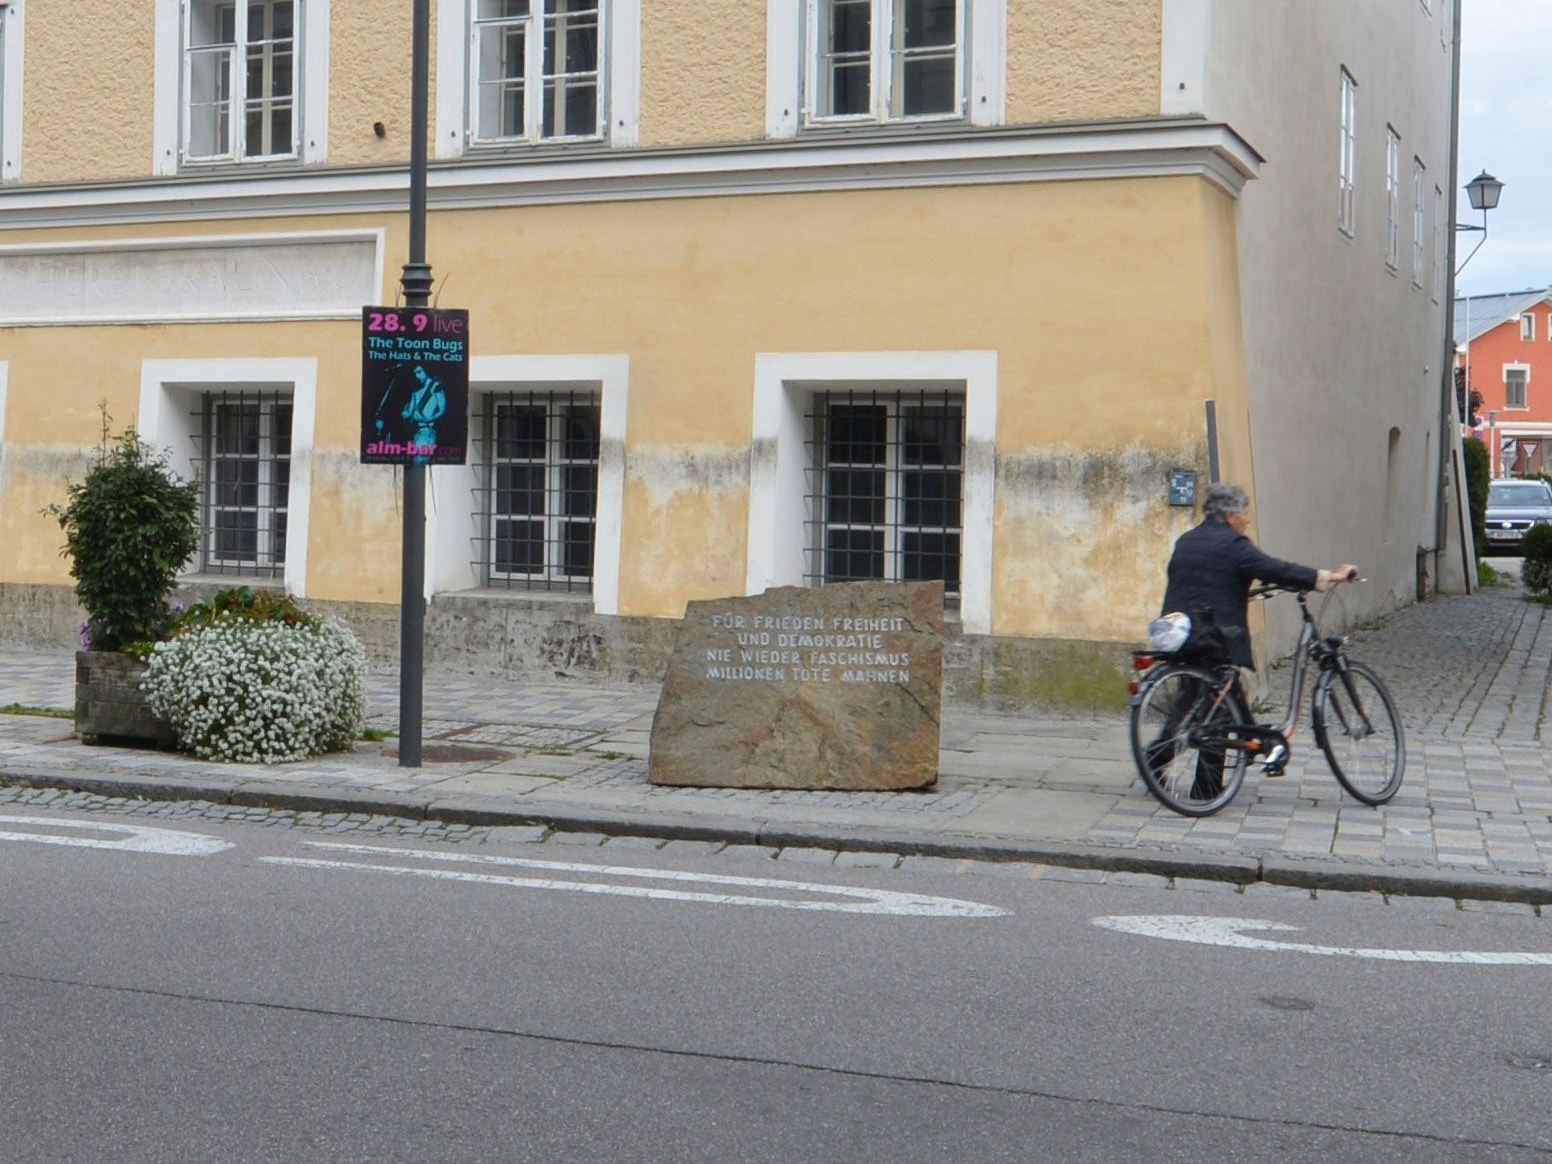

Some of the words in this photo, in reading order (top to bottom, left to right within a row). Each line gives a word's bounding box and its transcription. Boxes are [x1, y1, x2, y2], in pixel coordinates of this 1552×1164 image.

[368, 313, 406, 332] 28.
[412, 313, 428, 332] 9
[433, 313, 463, 334] live
[368, 336, 394, 348] The
[396, 337, 429, 349] Toon
[432, 338, 463, 353] Bugs
[368, 350, 388, 360] The
[390, 351, 411, 361] Hats
[413, 351, 421, 361] &
[423, 351, 441, 361] The
[443, 352, 463, 362] Cats
[713, 612, 746, 629] FÜR
[754, 615, 824, 630] FRIEDEN
[833, 617, 903, 631] FREIHEIT
[738, 632, 770, 646] UND
[778, 633, 882, 649] DEMOKRATIE
[707, 649, 731, 663] NIE
[741, 650, 801, 664] WIEDER
[810, 652, 911, 666] FASCHISMUS
[706, 667, 785, 681] MILLIONEN
[791, 667, 832, 682] TOTE
[841, 669, 910, 683] MAHNEN
